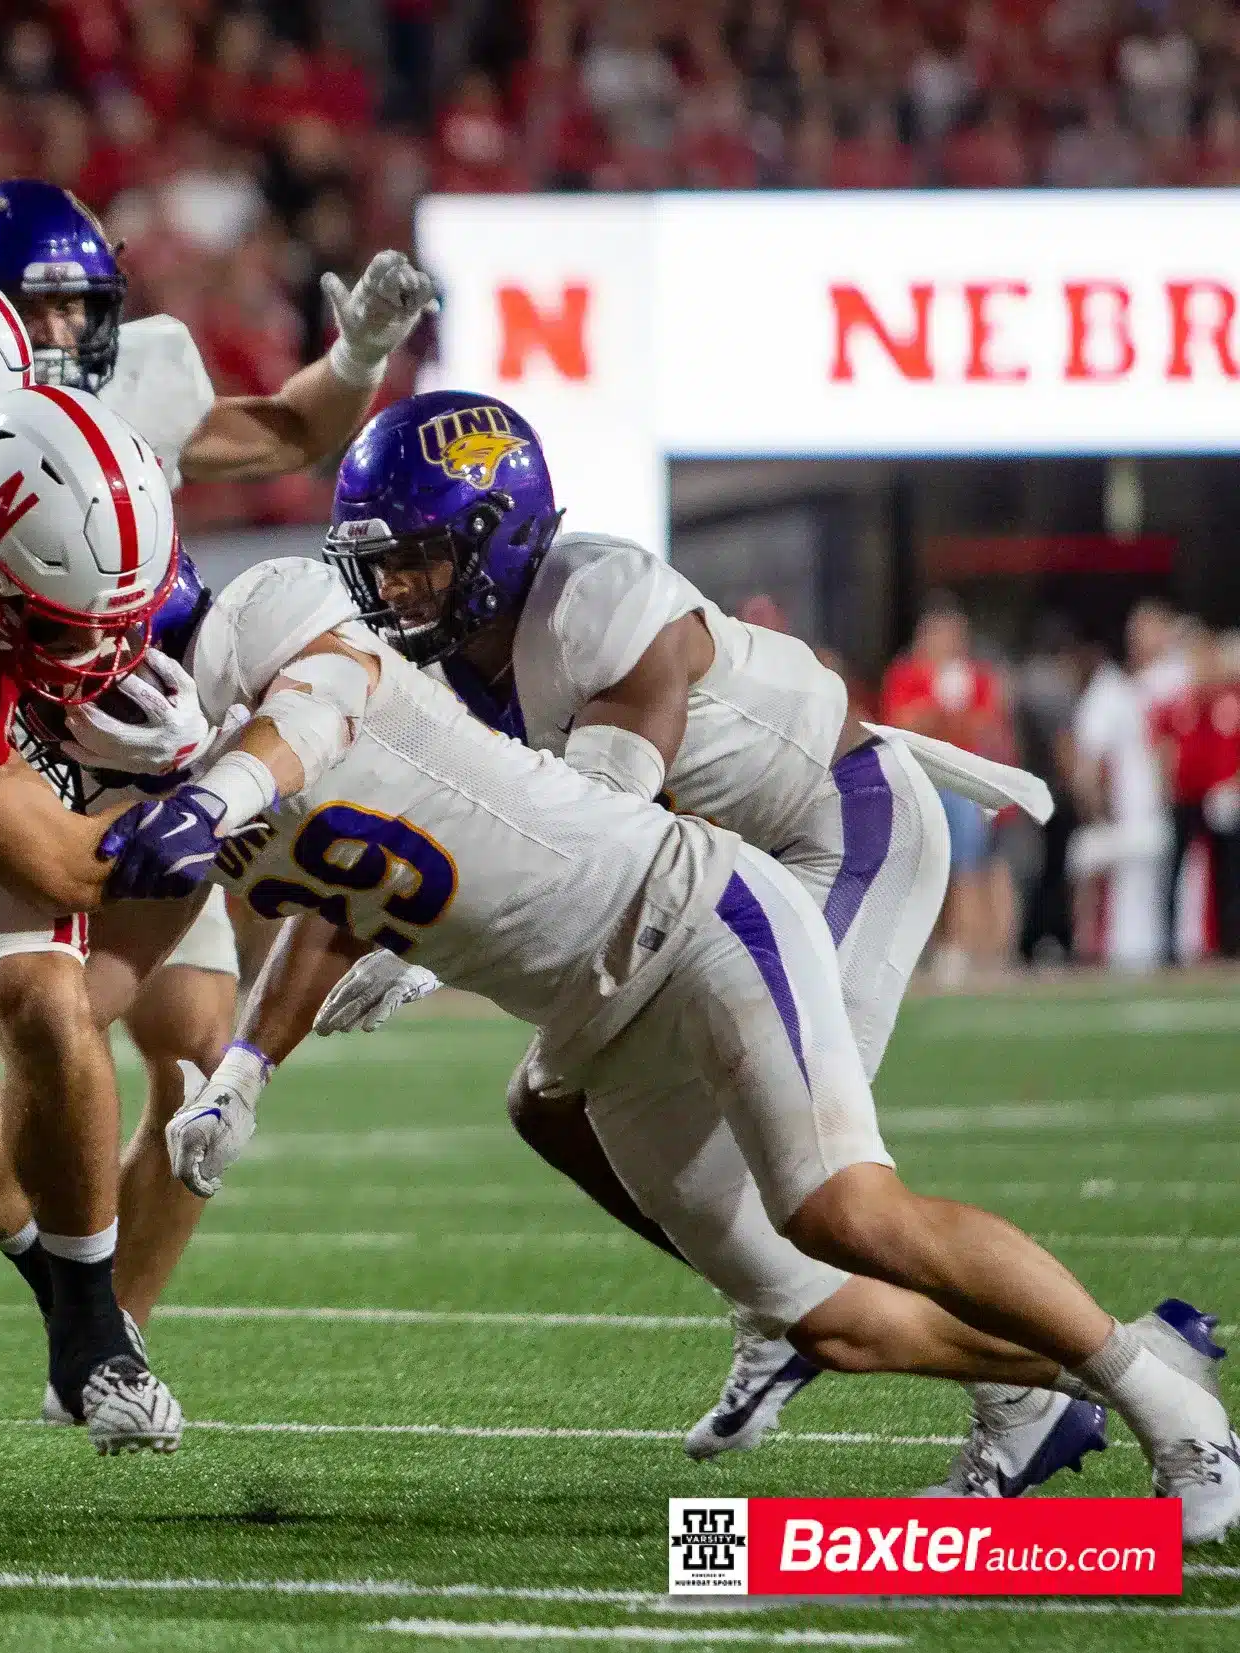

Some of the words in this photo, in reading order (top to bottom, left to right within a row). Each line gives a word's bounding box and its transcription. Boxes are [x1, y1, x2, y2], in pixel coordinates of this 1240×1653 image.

[497, 285, 589, 381] N
[829, 283, 1240, 381] NEBR
[418, 406, 512, 465] UNI
